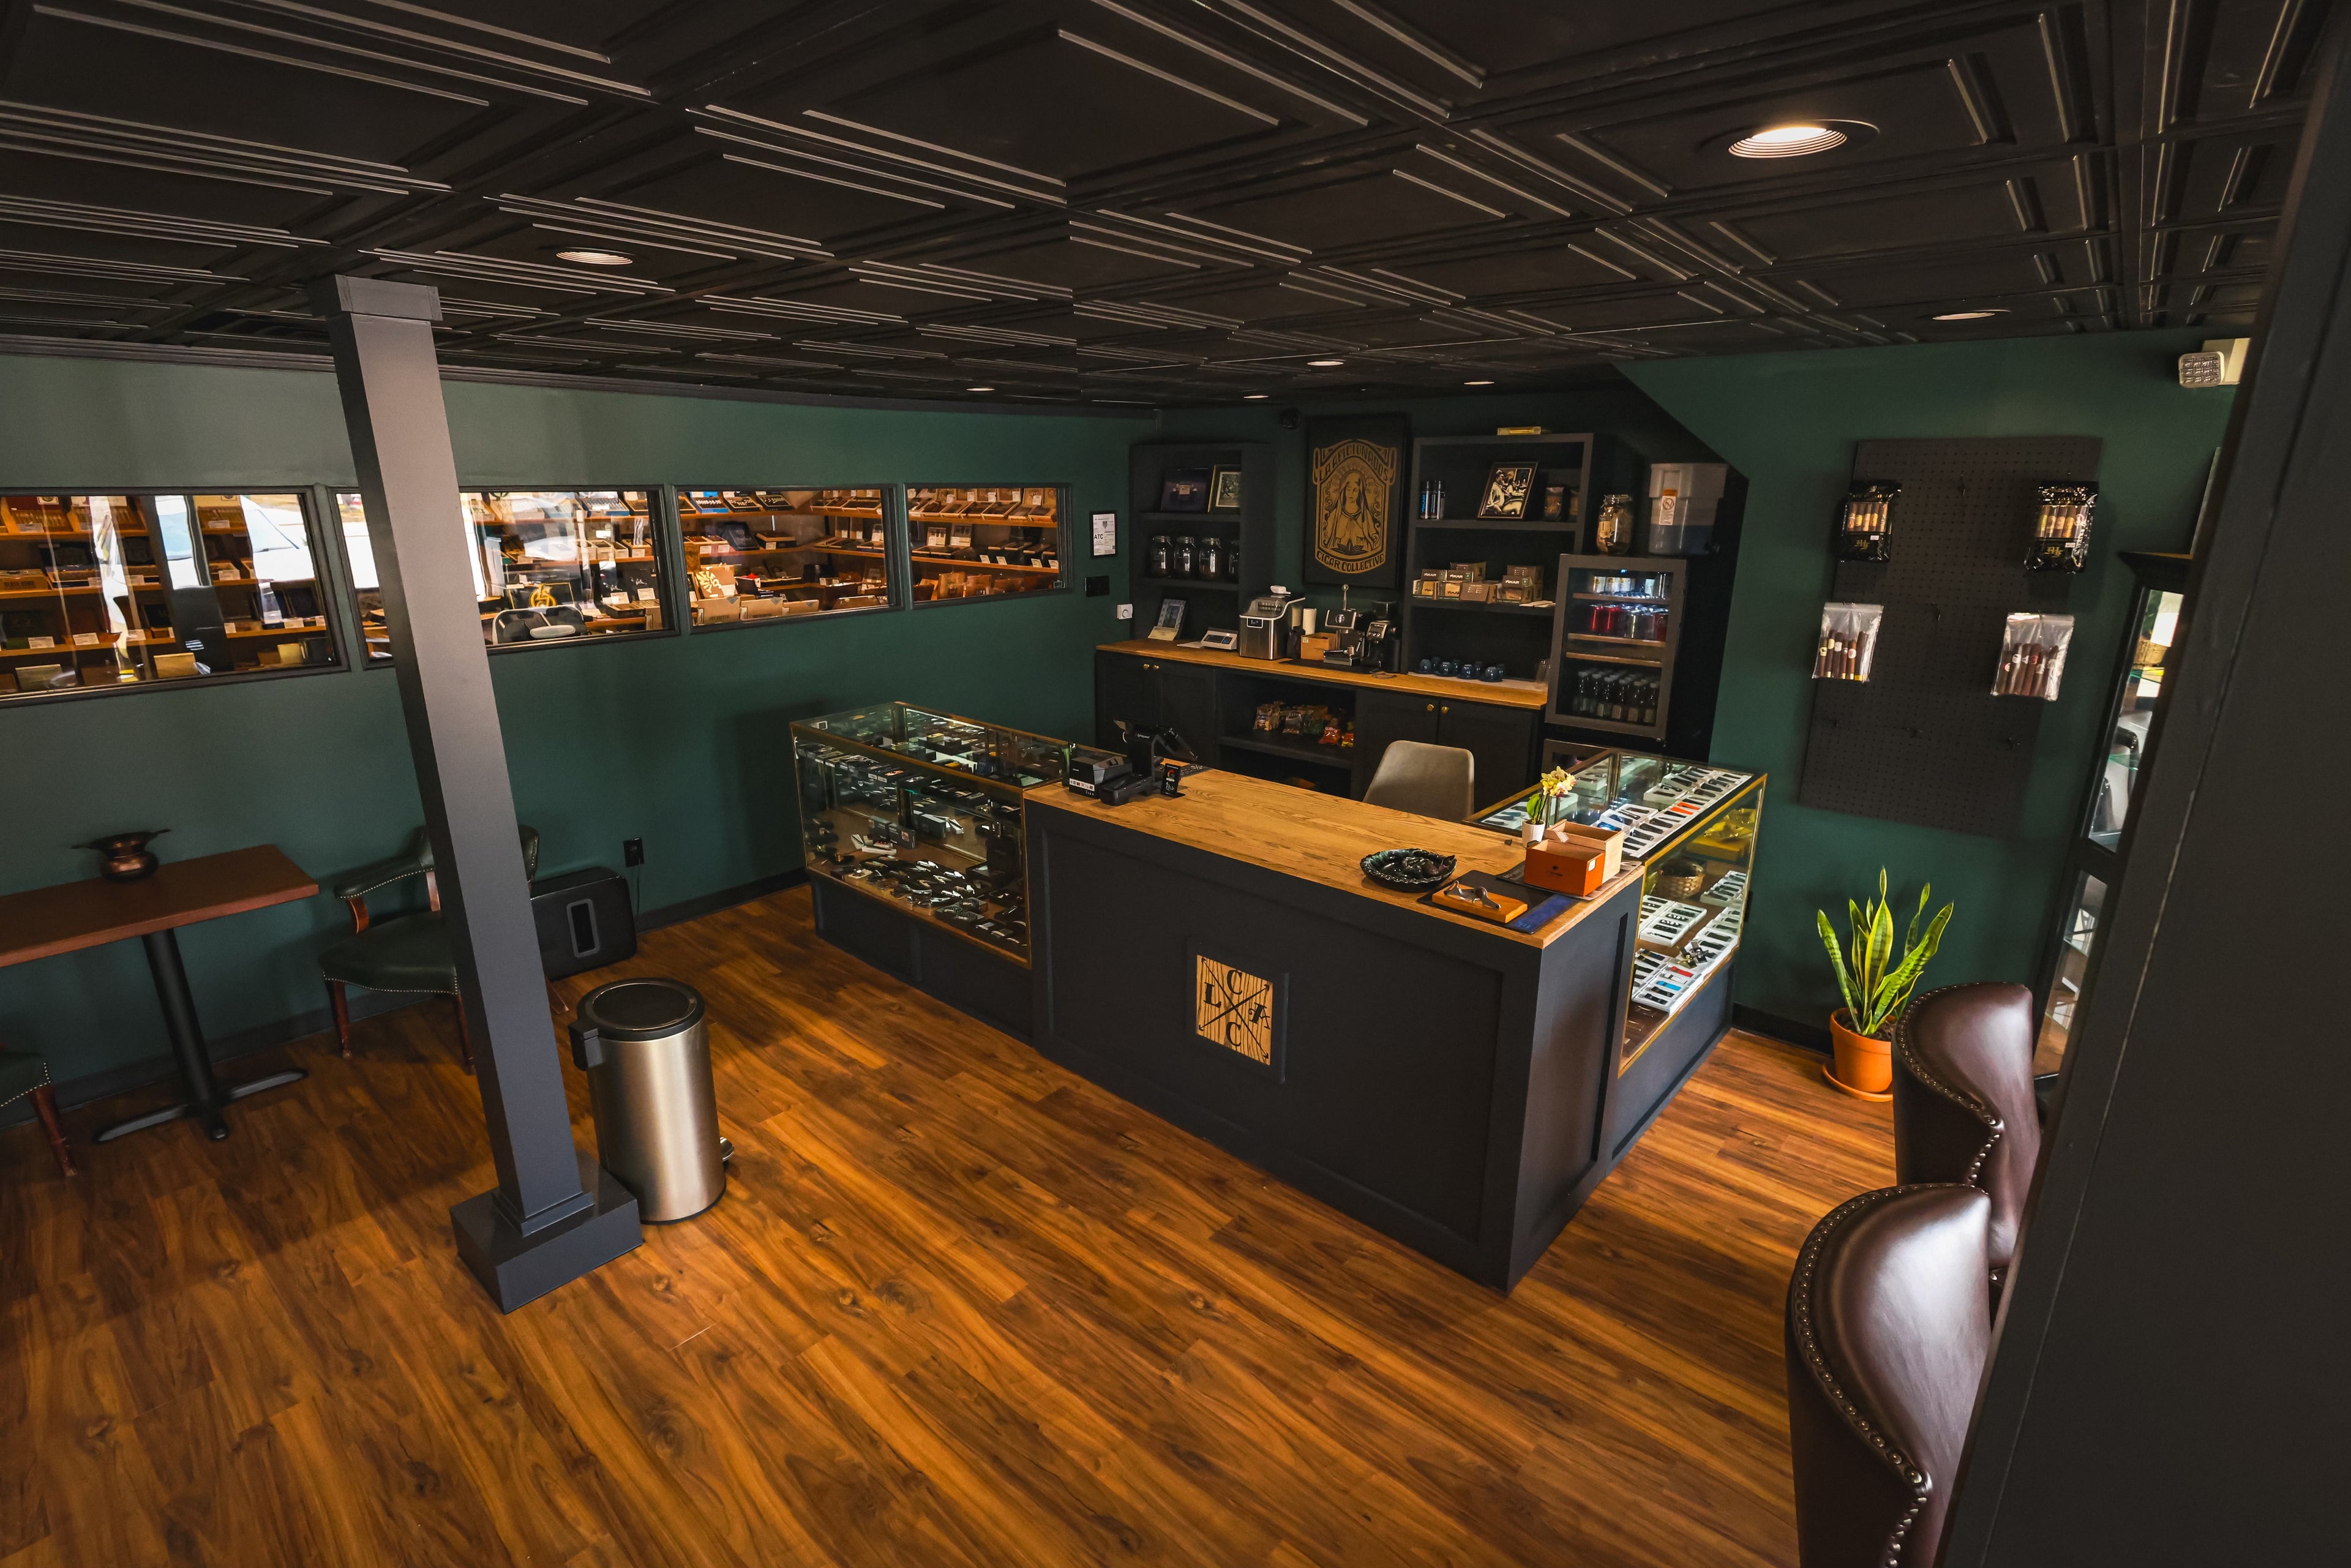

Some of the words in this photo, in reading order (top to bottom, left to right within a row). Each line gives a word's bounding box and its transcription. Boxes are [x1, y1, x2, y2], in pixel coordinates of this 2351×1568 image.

[1332, 444, 1389, 481] AFICIONADOS
[1316, 550, 1341, 570] CIGAR
[1341, 553, 1385, 572] COLLECTIVE
